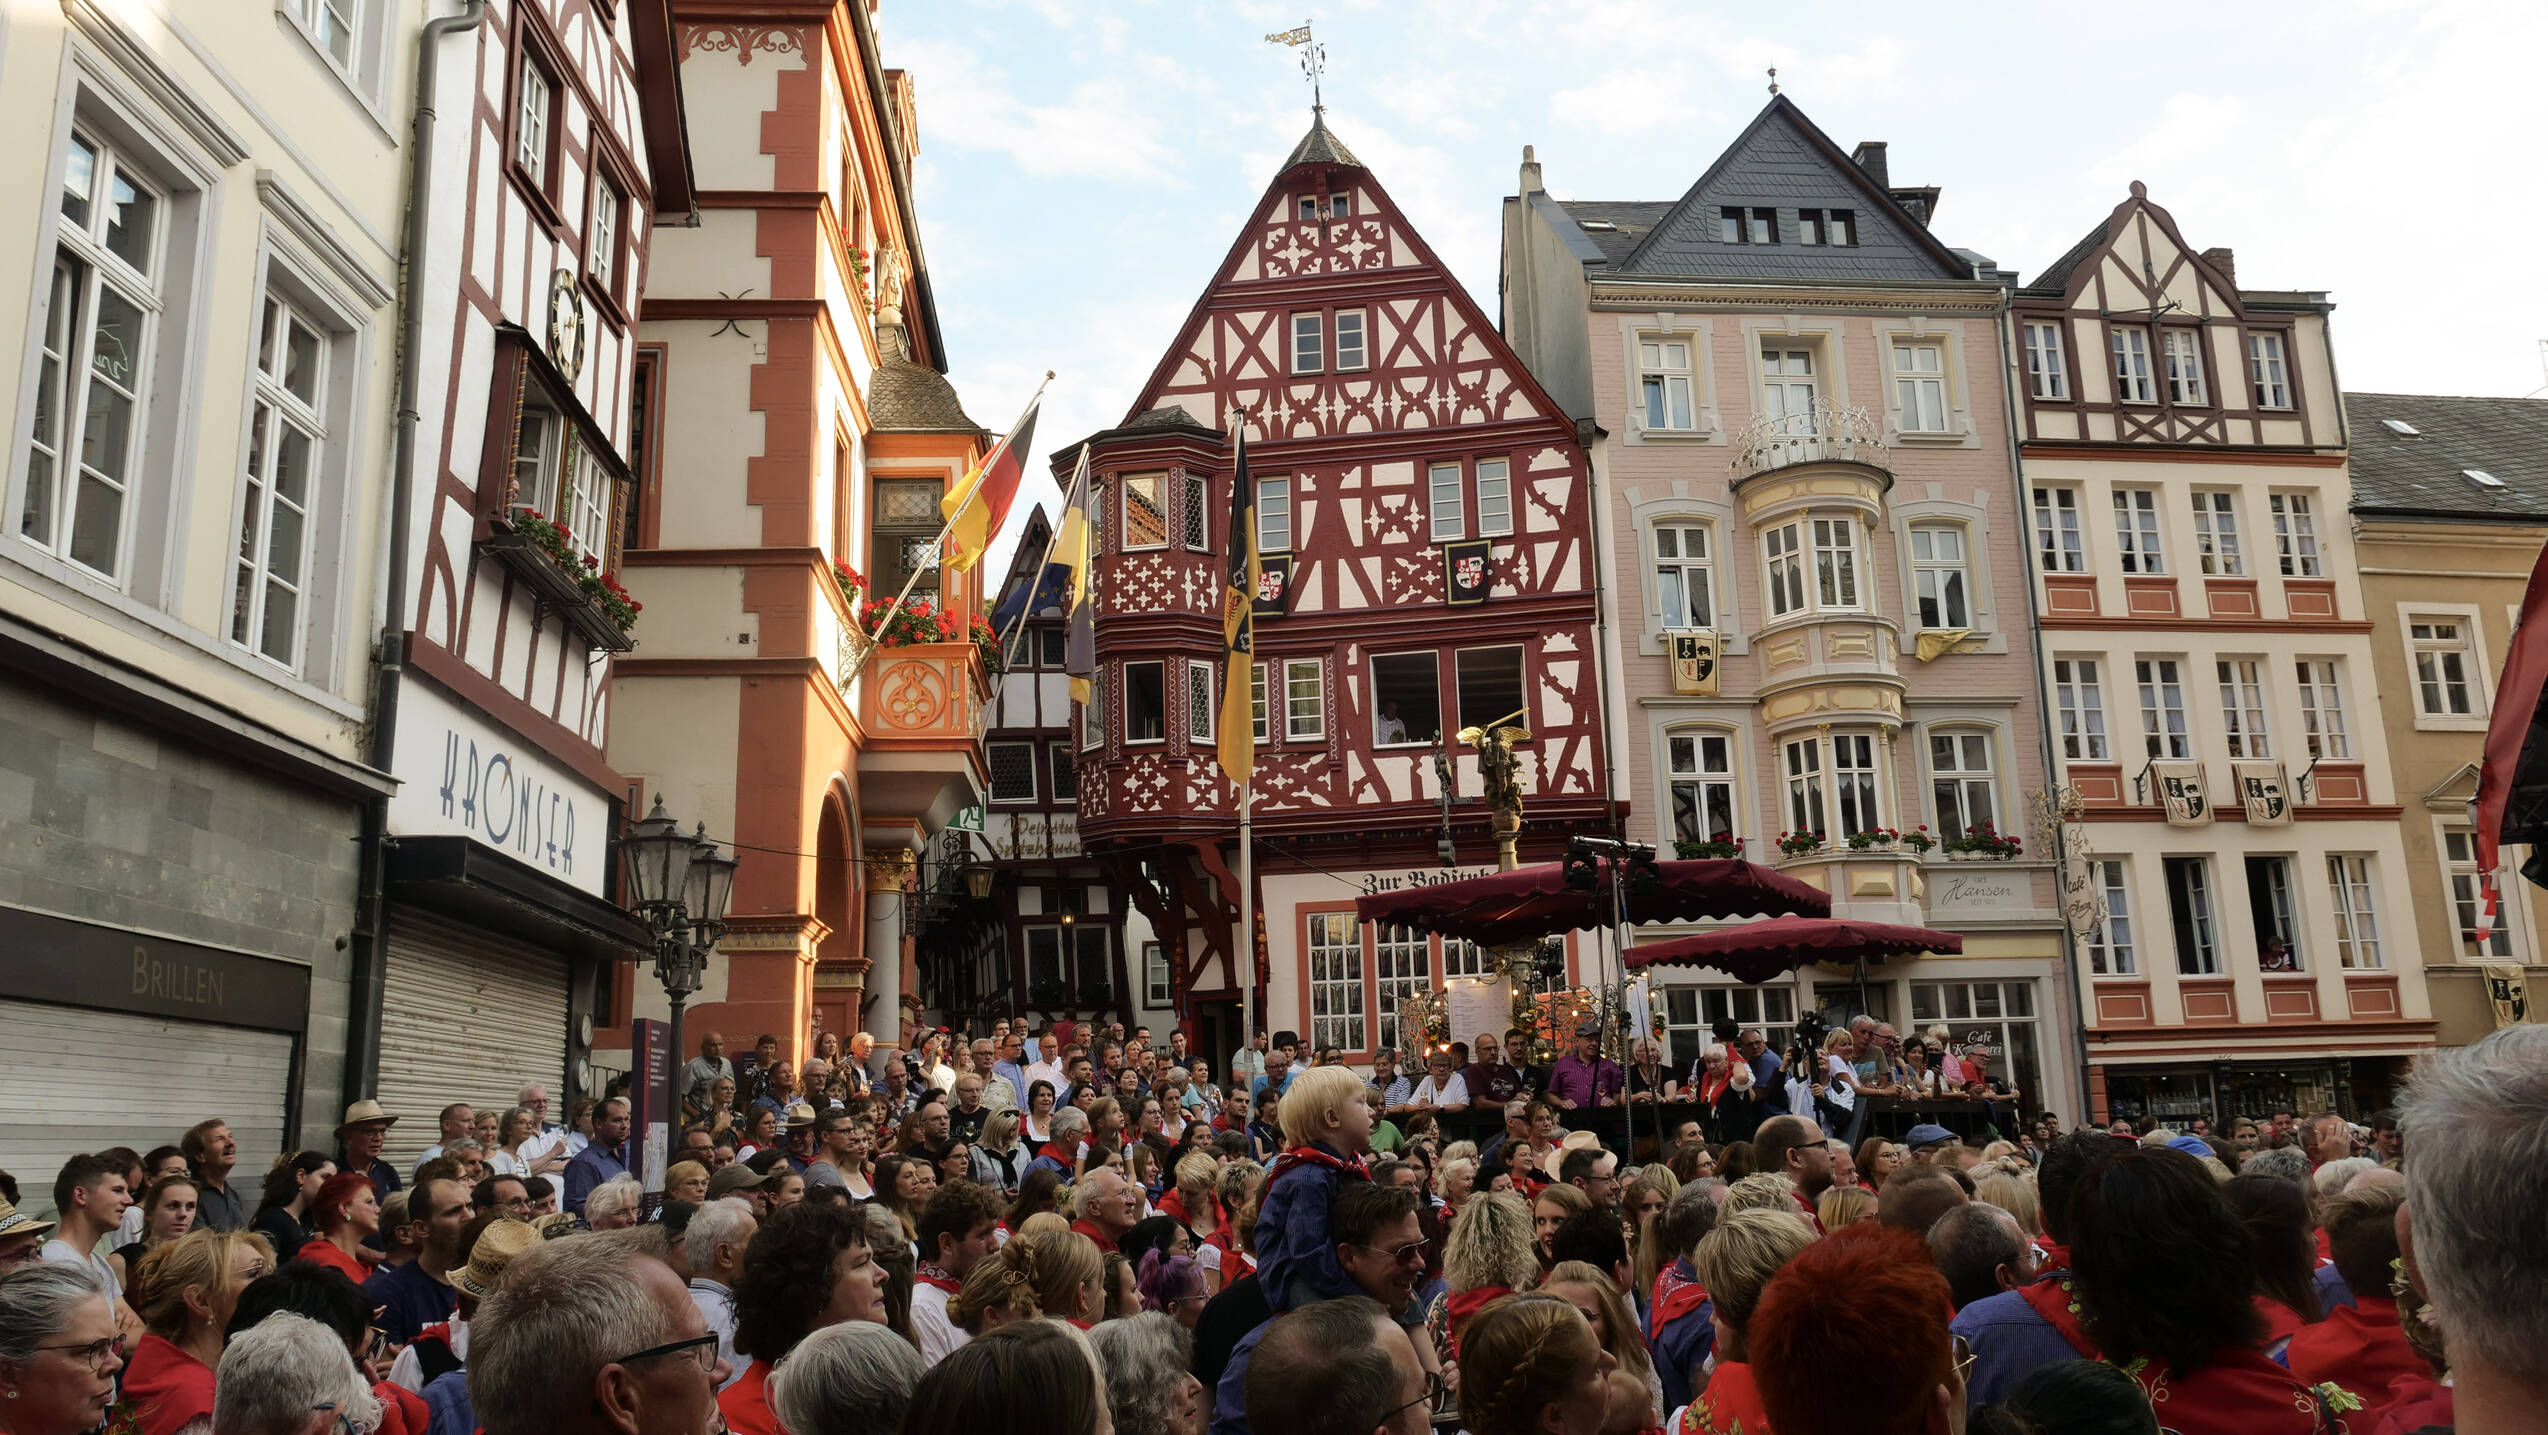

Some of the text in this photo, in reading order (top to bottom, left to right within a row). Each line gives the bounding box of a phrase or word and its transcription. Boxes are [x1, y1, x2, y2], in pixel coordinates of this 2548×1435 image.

[440, 729, 575, 876] KRONSER
[1361, 873, 1401, 896] Zur
[1941, 875, 2013, 905] Hansen
